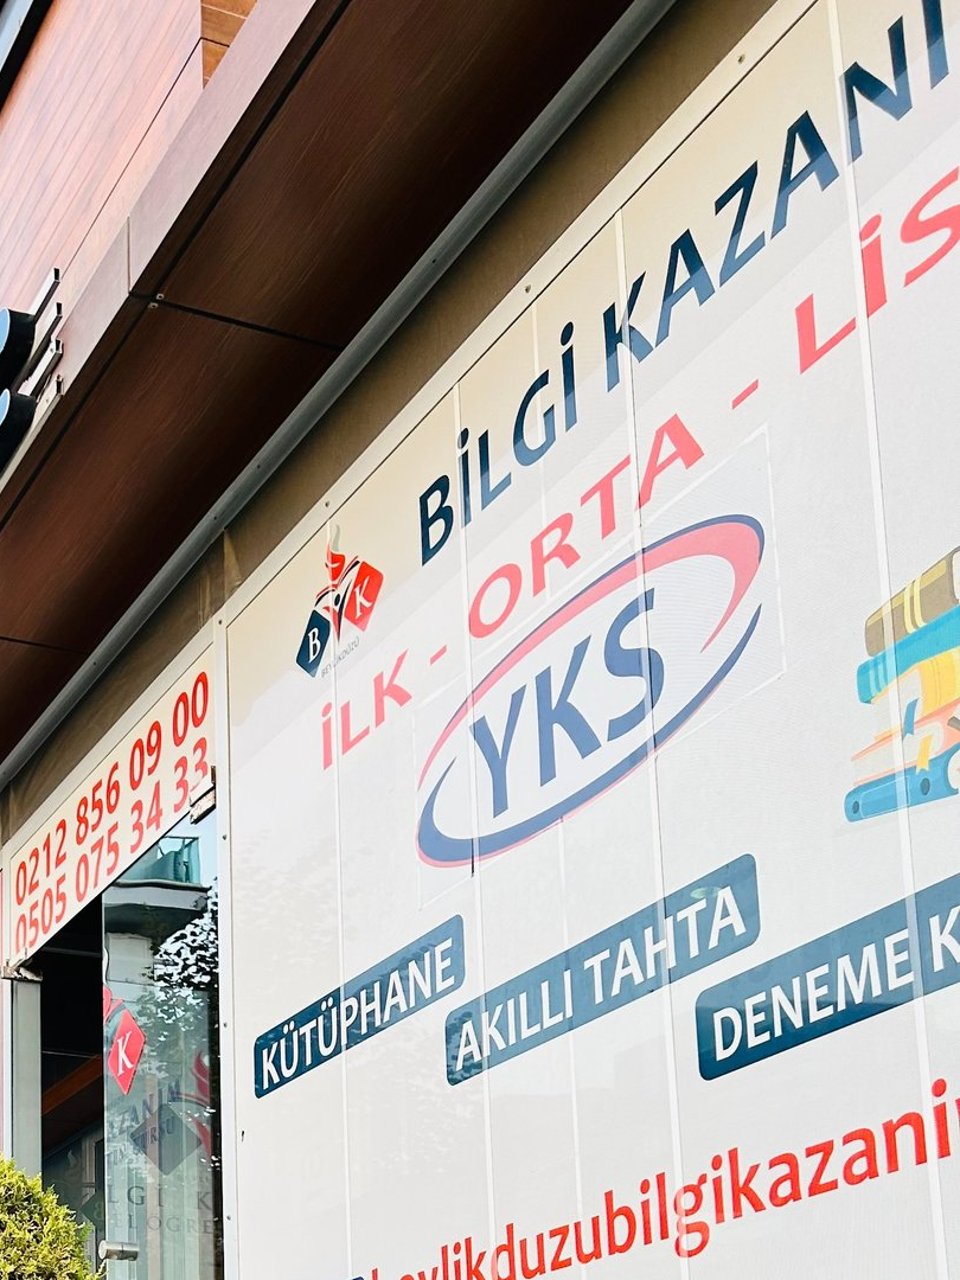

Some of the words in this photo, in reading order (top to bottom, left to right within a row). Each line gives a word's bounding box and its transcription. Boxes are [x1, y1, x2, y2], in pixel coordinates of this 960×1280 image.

[418, 321, 579, 566] BİLGİ
[321, 648, 413, 771] İLK
[468, 413, 705, 638] ORTA
[469, 587, 665, 818] YKS
[15, 818, 66, 906] 0212
[75, 761, 120, 846] 856
[129, 720, 162, 791] 09
[172, 671, 208, 747] 00
[15, 872, 66, 955] 0505
[75, 821, 120, 902] 075
[130, 781, 163, 854] 34
[173, 737, 208, 813] 33
[261, 938, 456, 1091] KÜTÜPHANE
[455, 969, 574, 1072] AKILLI
[584, 885, 746, 1006] TAHTA
[714, 928, 915, 1062] DENEME
